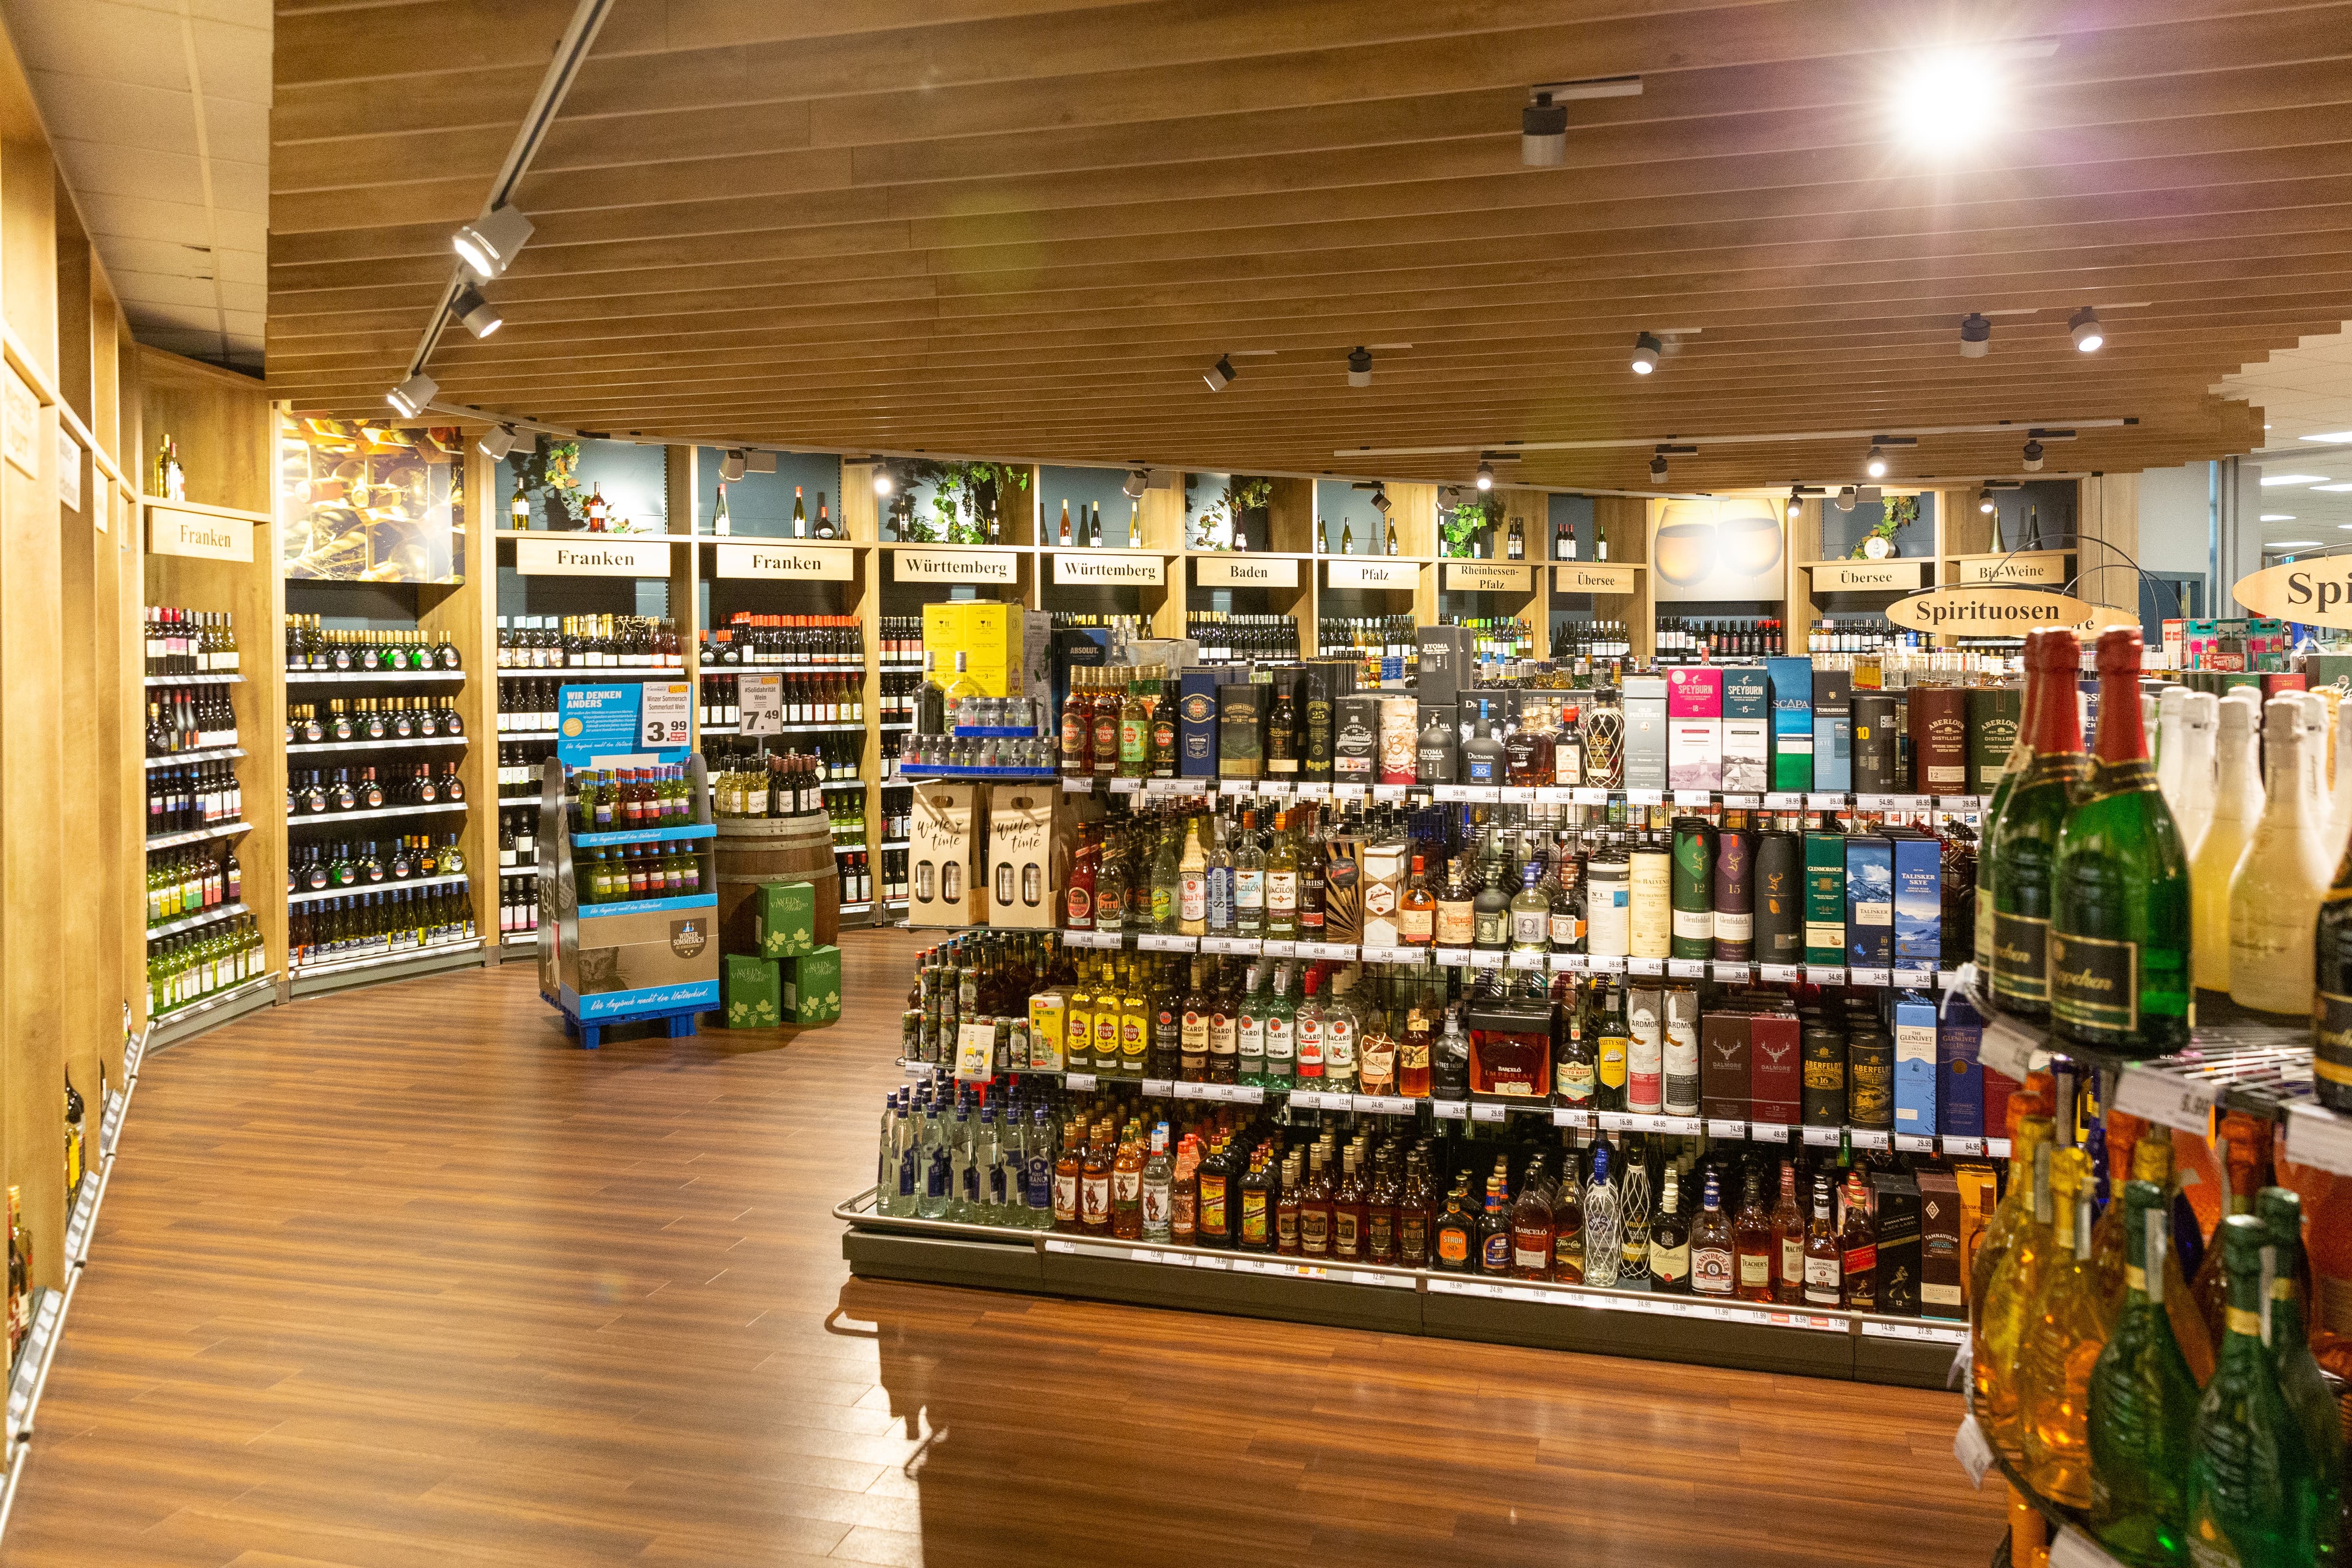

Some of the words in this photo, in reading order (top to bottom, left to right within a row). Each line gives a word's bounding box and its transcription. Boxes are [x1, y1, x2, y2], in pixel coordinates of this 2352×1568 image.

[180, 524, 231, 548] Franken
[557, 549, 635, 566] Franken
[753, 554, 821, 570] Franken
[906, 558, 1007, 578] Württemberg
[1065, 562, 1156, 580] Württemberg
[1230, 565, 1268, 578] Baden
[1361, 568, 1389, 581] Pfalz
[1461, 565, 1519, 577] Rheinhessen-
[1979, 565, 2044, 578] Bio-Weine
[1578, 572, 1615, 586] Übersee
[1840, 570, 1892, 584] Übersee
[1479, 579, 1504, 590] Pfalz
[1916, 601, 2059, 626] Spirituosen
[567, 691, 583, 700] WIR
[586, 690, 622, 699] DENKEN
[1678, 685, 1713, 694] SPEYBURN
[1728, 686, 1763, 695] SPEYBURN
[566, 699, 602, 708] ANDERS
[1772, 699, 1809, 709] SCAPA
[743, 710, 779, 730] 7.49
[1928, 718, 1964, 731] ABERLOUR
[647, 721, 687, 742] 3.99
[1857, 727, 1869, 740] 10
[917, 817, 950, 838] wine
[997, 819, 1031, 840] wine
[932, 833, 961, 851] time
[1011, 835, 1041, 853] time
[1213, 871, 1224, 909] Sagatiba
[1268, 886, 1294, 894] VACILÓN
[1693, 883, 1705, 893] 12
[1728, 883, 1740, 894] 15
[1719, 916, 1748, 925] Glenfiddich
[673, 936, 704, 946] SOMMERACH
[1804, 1060, 1842, 1069] ABERFELDY
[1854, 1064, 1891, 1074] ABERFELDY
[1515, 1226, 1547, 1235] BARCELÓ
[1924, 1232, 1959, 1242] TAMNAVULIN
[1696, 1253, 1730, 1272] PENNYPACKER
[1807, 1265, 1838, 1274] WASHINGTON
